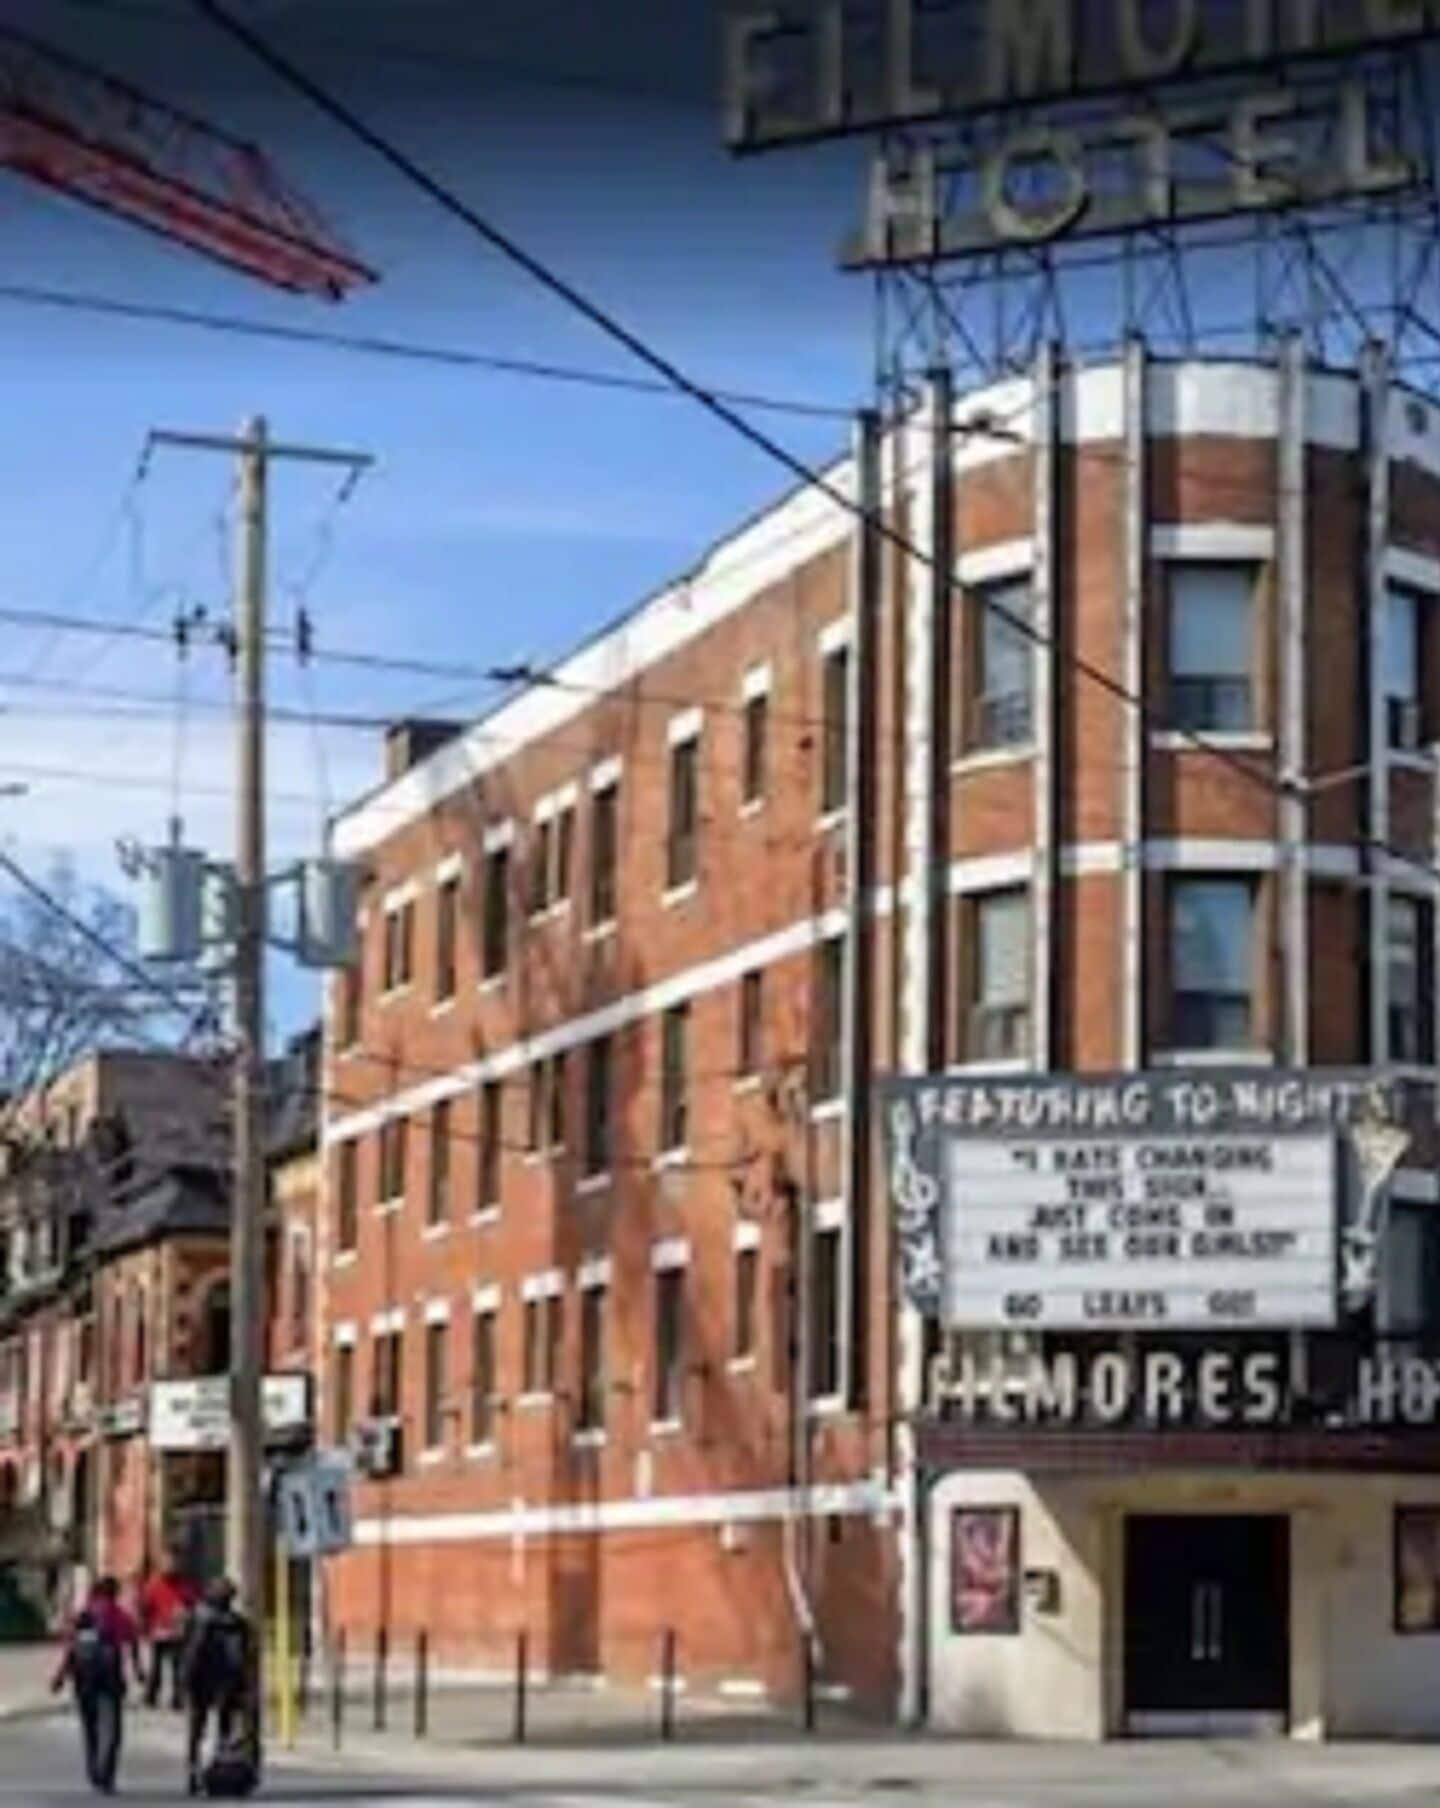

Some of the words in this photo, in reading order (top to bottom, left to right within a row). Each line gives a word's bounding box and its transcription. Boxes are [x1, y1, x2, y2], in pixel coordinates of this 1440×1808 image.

[868, 80, 1410, 262] HOTEL
[917, 1082, 1150, 1126] FEATURING
[1136, 1145, 1273, 1173] CHANGING
[1068, 1176, 1123, 1200] THIS
[1029, 1203, 1085, 1228] JUST
[1108, 1203, 1181, 1228] COME
[1204, 1203, 1234, 1227] IN
[987, 1232, 1038, 1261] AND
[1059, 1231, 1108, 1260] SEE
[1124, 1231, 1180, 1258] OUR
[1004, 1293, 1043, 1319] GO
[1082, 1291, 1168, 1318] LEAFS
[926, 1351, 1277, 1424] FILMORES
